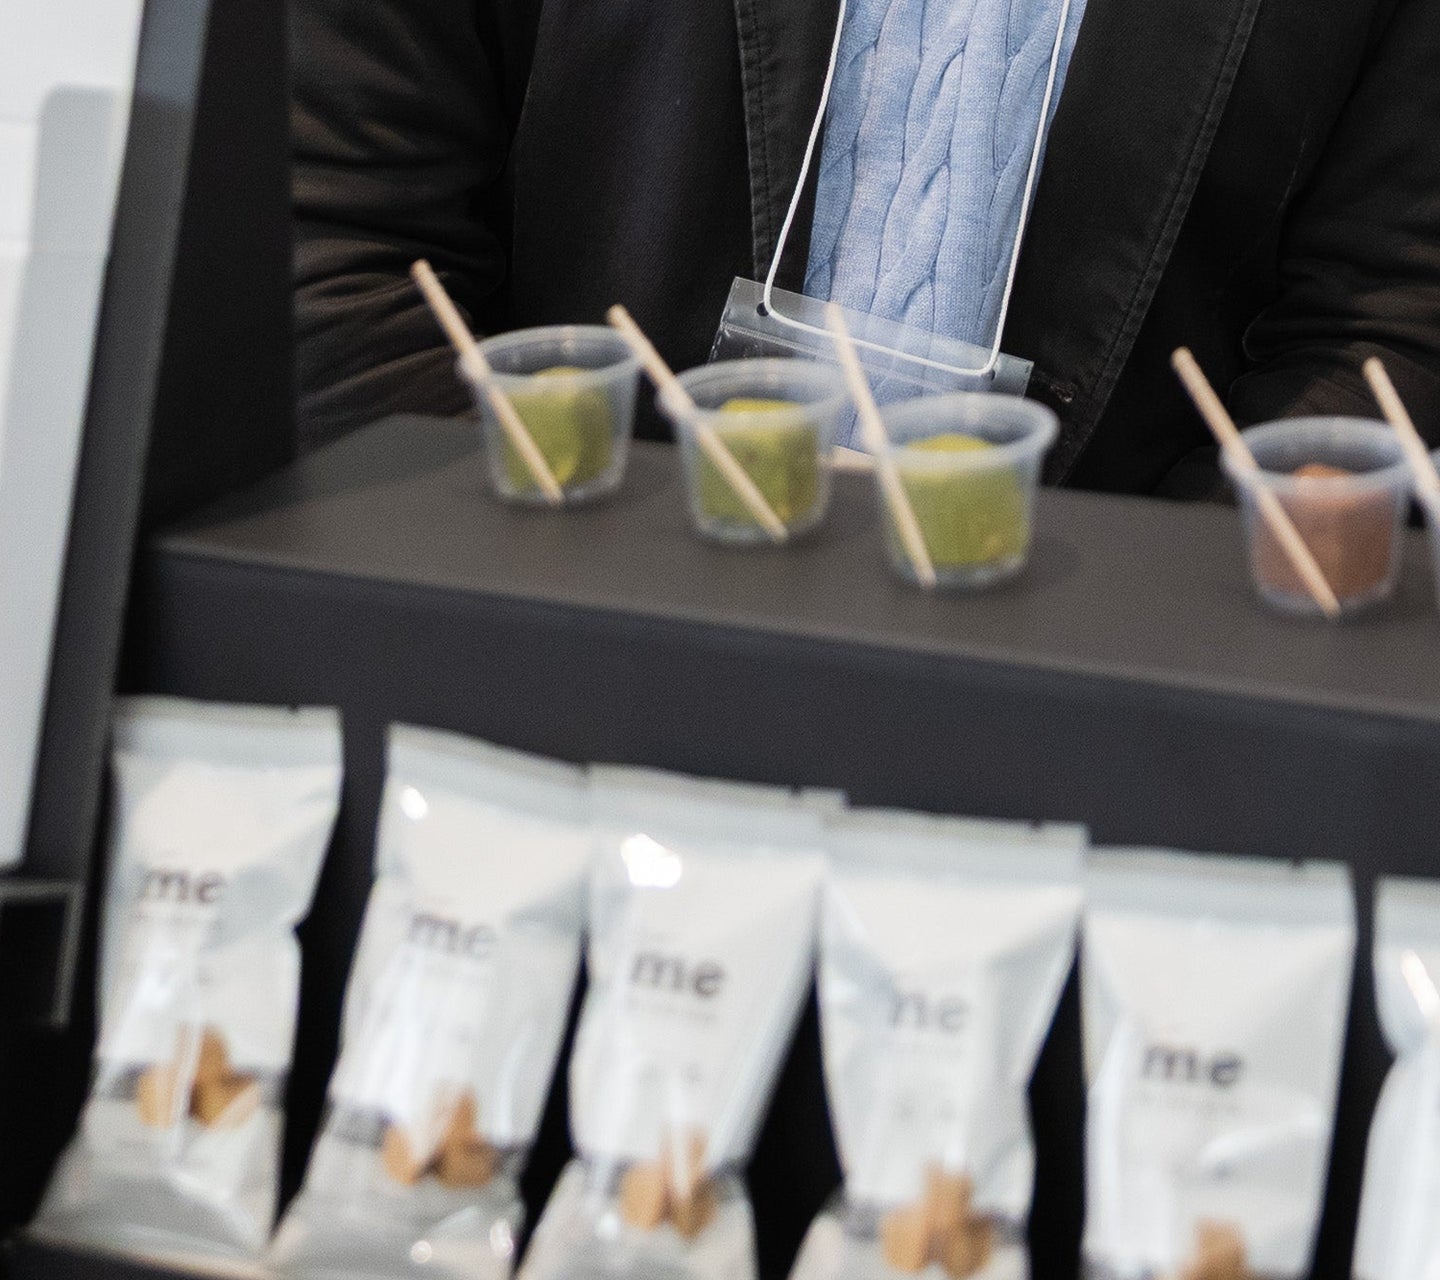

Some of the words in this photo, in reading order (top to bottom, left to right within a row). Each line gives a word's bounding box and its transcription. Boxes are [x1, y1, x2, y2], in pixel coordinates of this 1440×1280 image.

[137, 864, 226, 906] me
[409, 908, 499, 962] me
[632, 947, 729, 1000] me
[1140, 1041, 1246, 1089] me
